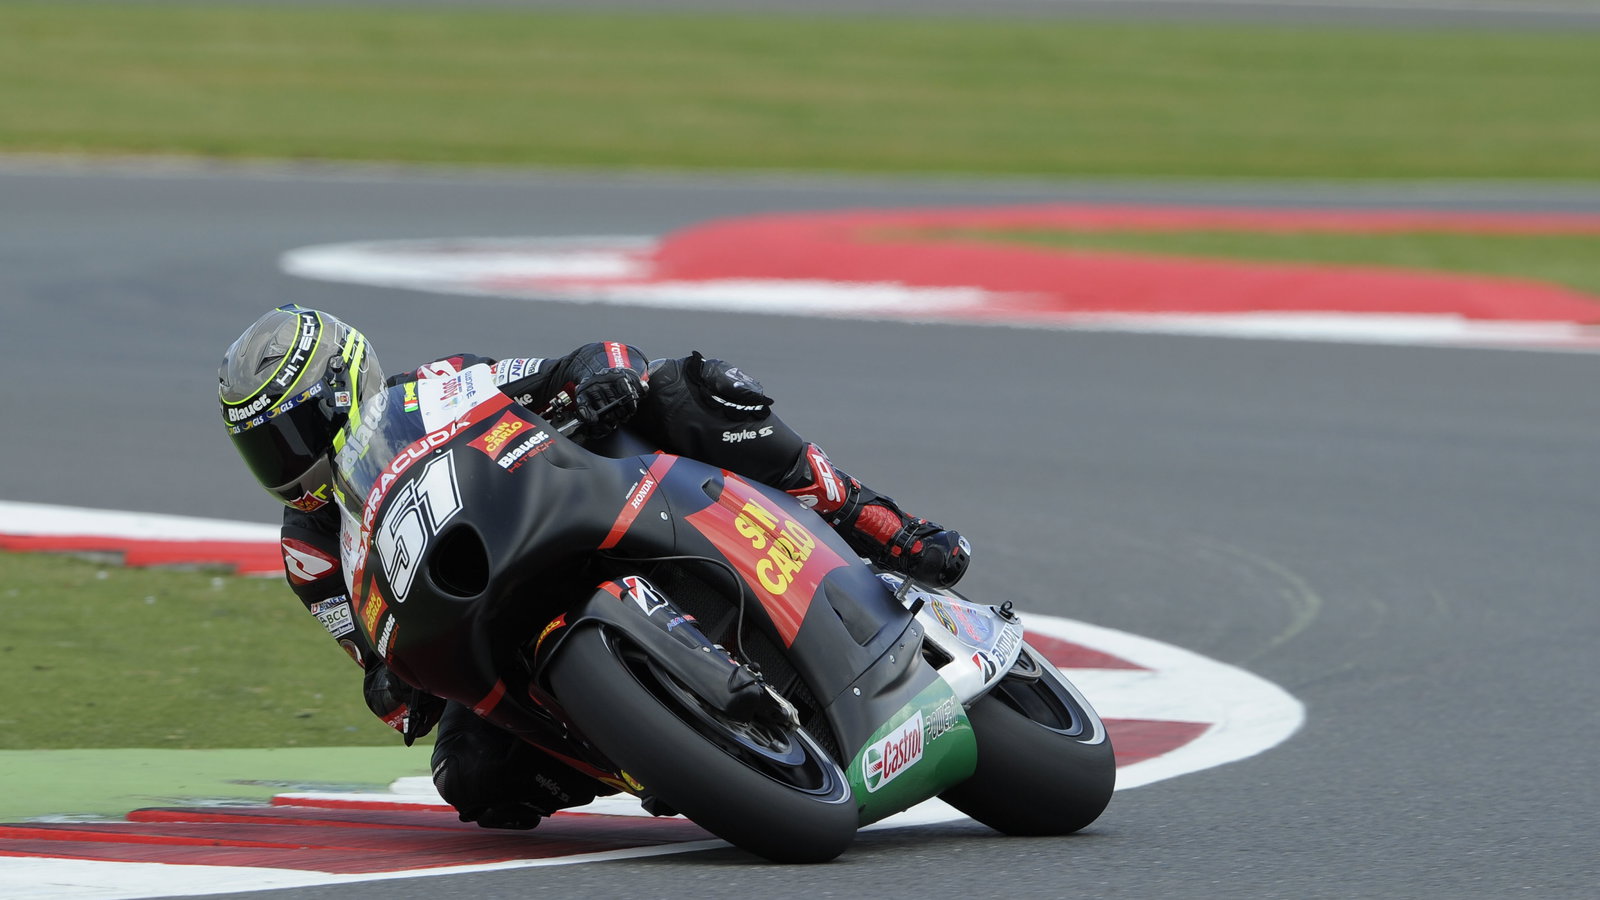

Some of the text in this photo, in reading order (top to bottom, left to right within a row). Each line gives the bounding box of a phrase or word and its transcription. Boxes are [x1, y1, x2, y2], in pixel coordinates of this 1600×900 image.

[276, 315, 315, 387] HI.TECH
[309, 384, 322, 396] GLS
[252, 416, 264, 427] GLS
[280, 400, 293, 413] GLS
[484, 421, 510, 443] SAN
[486, 421, 523, 452] CARLO
[722, 431, 756, 443] Spyke
[631, 479, 654, 509] HONDA
[375, 448, 463, 603] 51
[756, 520, 816, 595] CARLO
[367, 596, 382, 632] CARLO
[883, 718, 922, 779] Castrol
